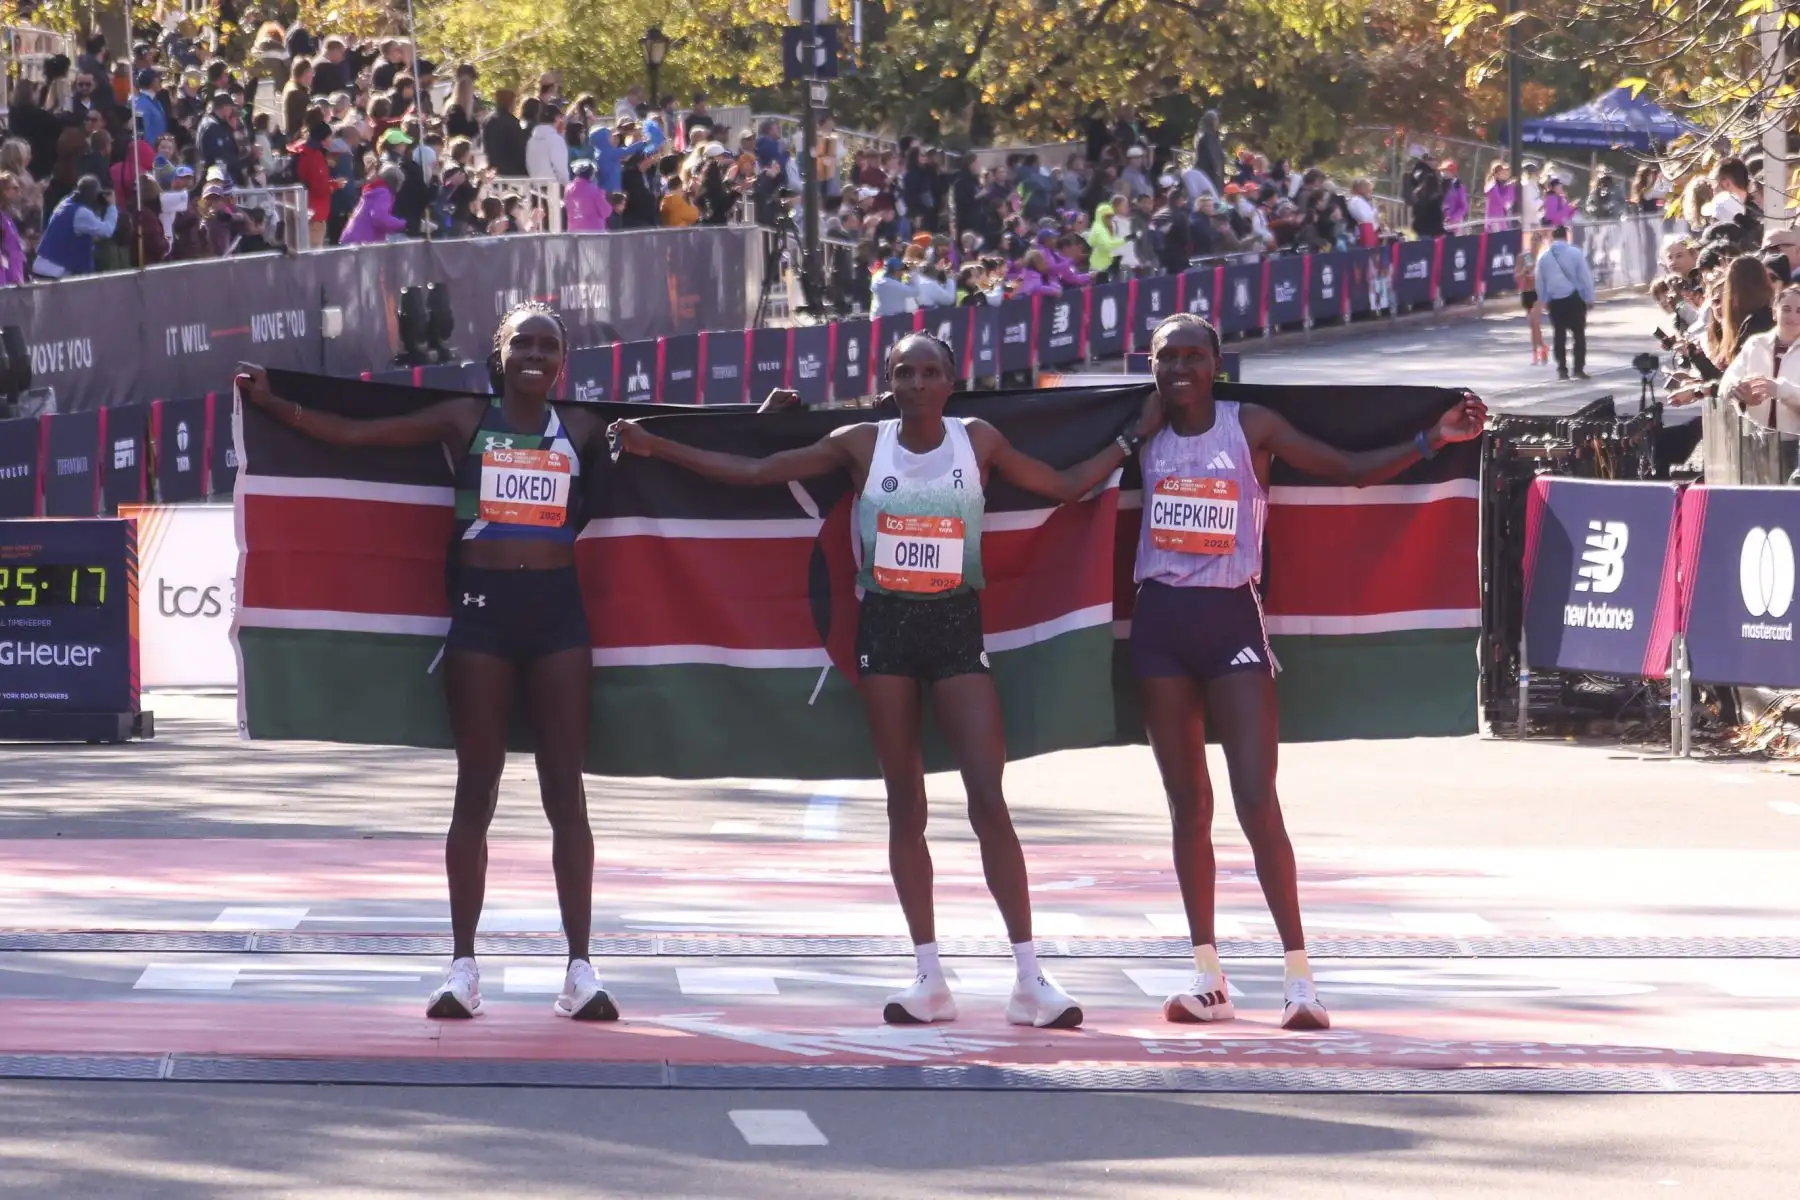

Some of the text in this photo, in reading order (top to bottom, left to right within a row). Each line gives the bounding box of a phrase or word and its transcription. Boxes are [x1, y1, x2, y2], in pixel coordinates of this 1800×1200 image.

[165, 310, 306, 357] IT WILL MOVE YOU
[66, 337, 93, 369] YOU
[496, 473, 557, 502] LOKEDI
[886, 516, 904, 531] tcs
[1153, 501, 1234, 530] CHEPKIRUI
[895, 541, 940, 569] OBIRI
[158, 577, 222, 618] tcs
[8, 619, 52, 627] TIMEKEEPER
[1564, 601, 1634, 631] new balance
[1741, 621, 1793, 641] mastercard
[20, 692, 38, 700] ROAD
[39, 692, 69, 700] RUNNERS
